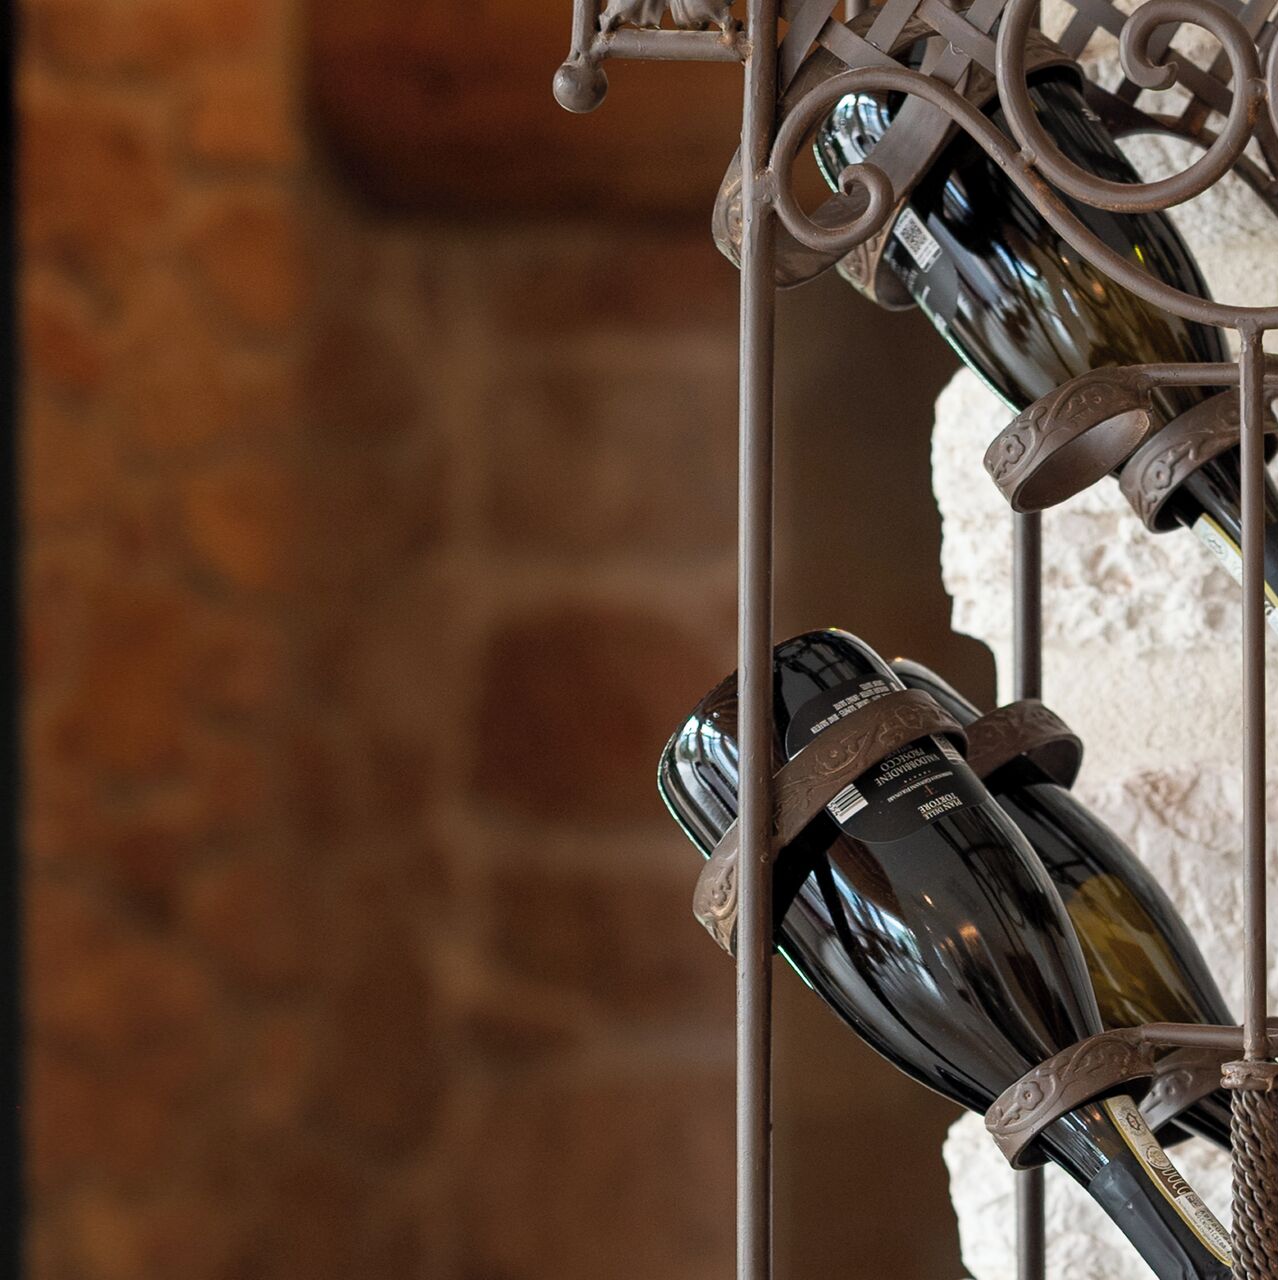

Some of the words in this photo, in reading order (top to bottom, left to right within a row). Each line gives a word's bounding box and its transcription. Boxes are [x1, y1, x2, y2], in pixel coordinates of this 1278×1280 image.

[874, 753, 940, 787] VALDOBBIADENE
[880, 747, 925, 771] PROSECCO
[918, 792, 956, 814] TORTORE
[923, 806, 944, 820] DELLE
[939, 796, 962, 811] PIAN
